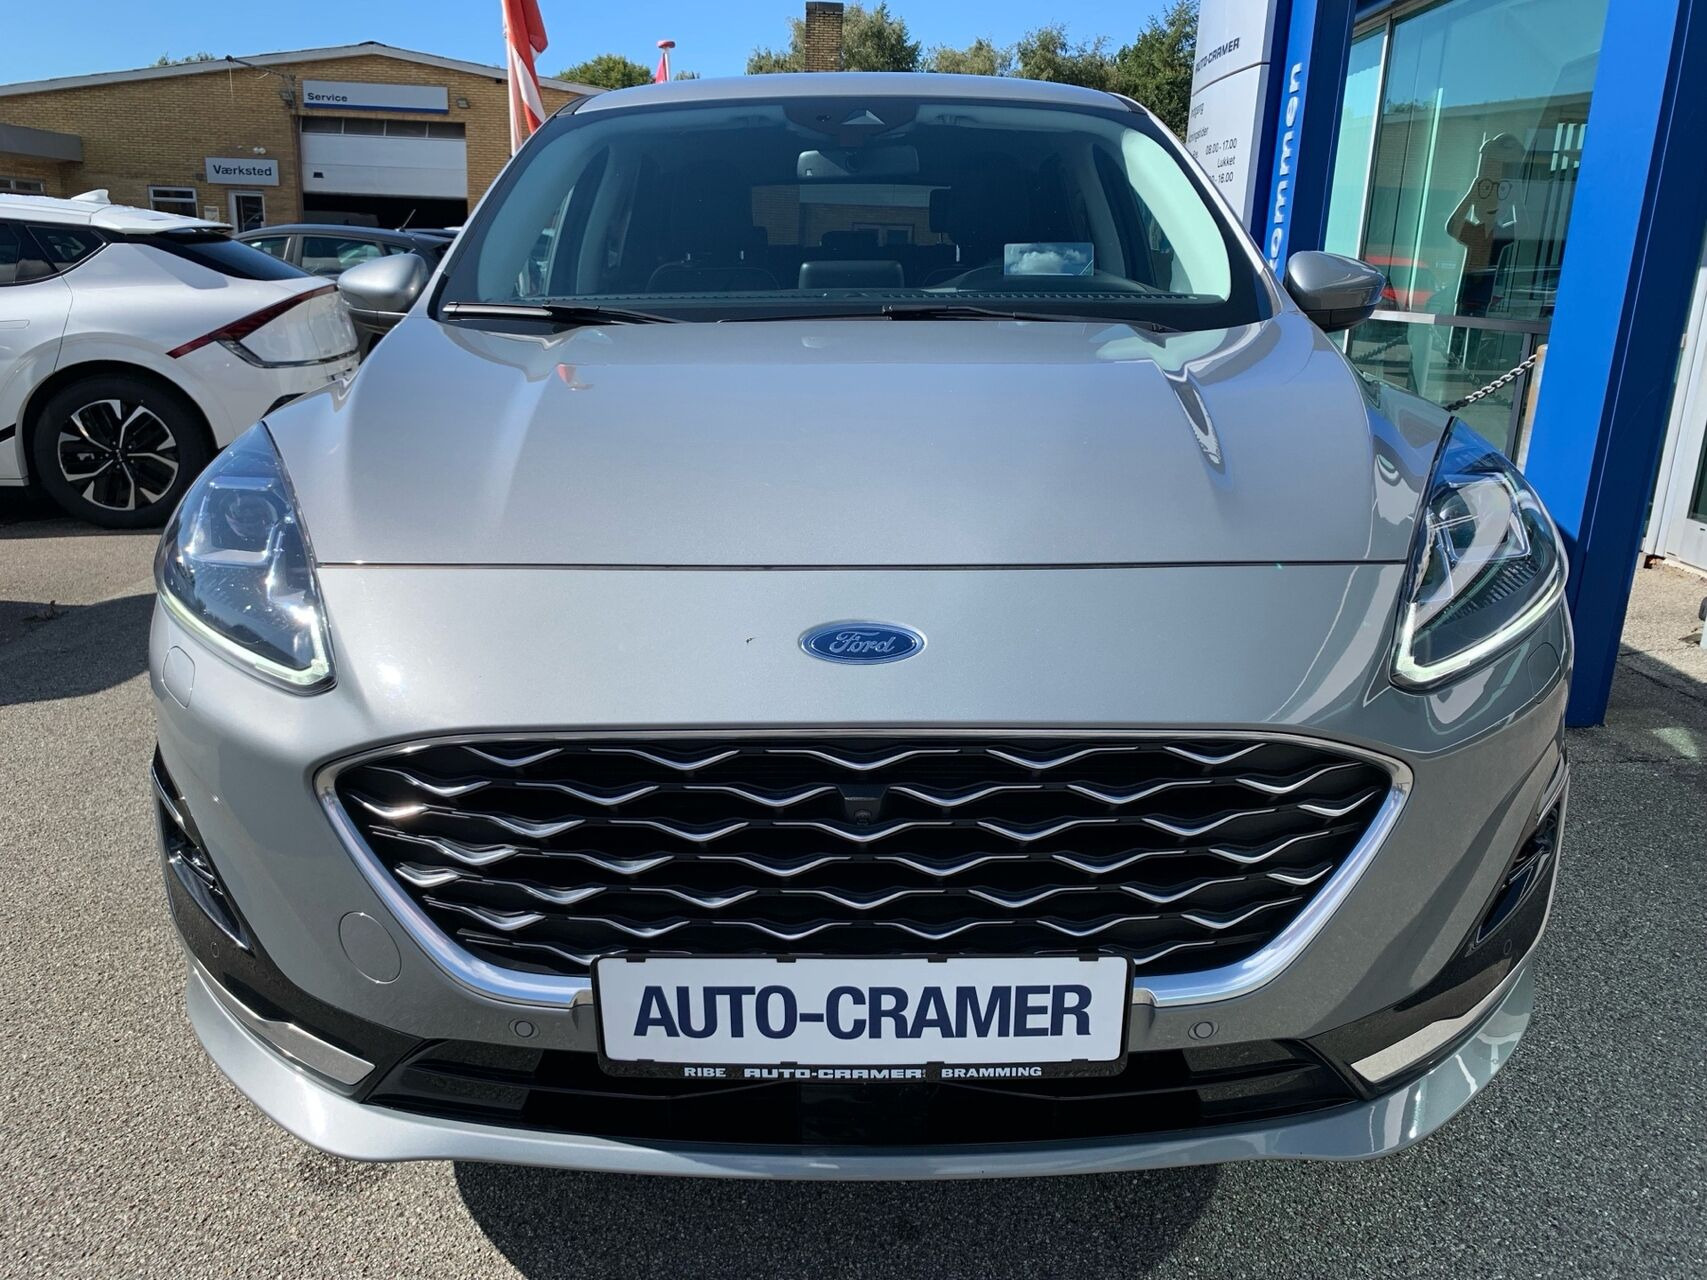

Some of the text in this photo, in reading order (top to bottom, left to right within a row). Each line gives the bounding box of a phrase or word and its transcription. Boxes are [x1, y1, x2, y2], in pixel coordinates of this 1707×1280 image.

[307, 92, 348, 103] Service
[213, 164, 272, 177] Værksted
[829, 631, 896, 653] Ford
[633, 984, 1091, 1039] AUTO-CRAMER
[684, 1067, 726, 1077] RIBE
[941, 1066, 1042, 1078] BRAMMING
